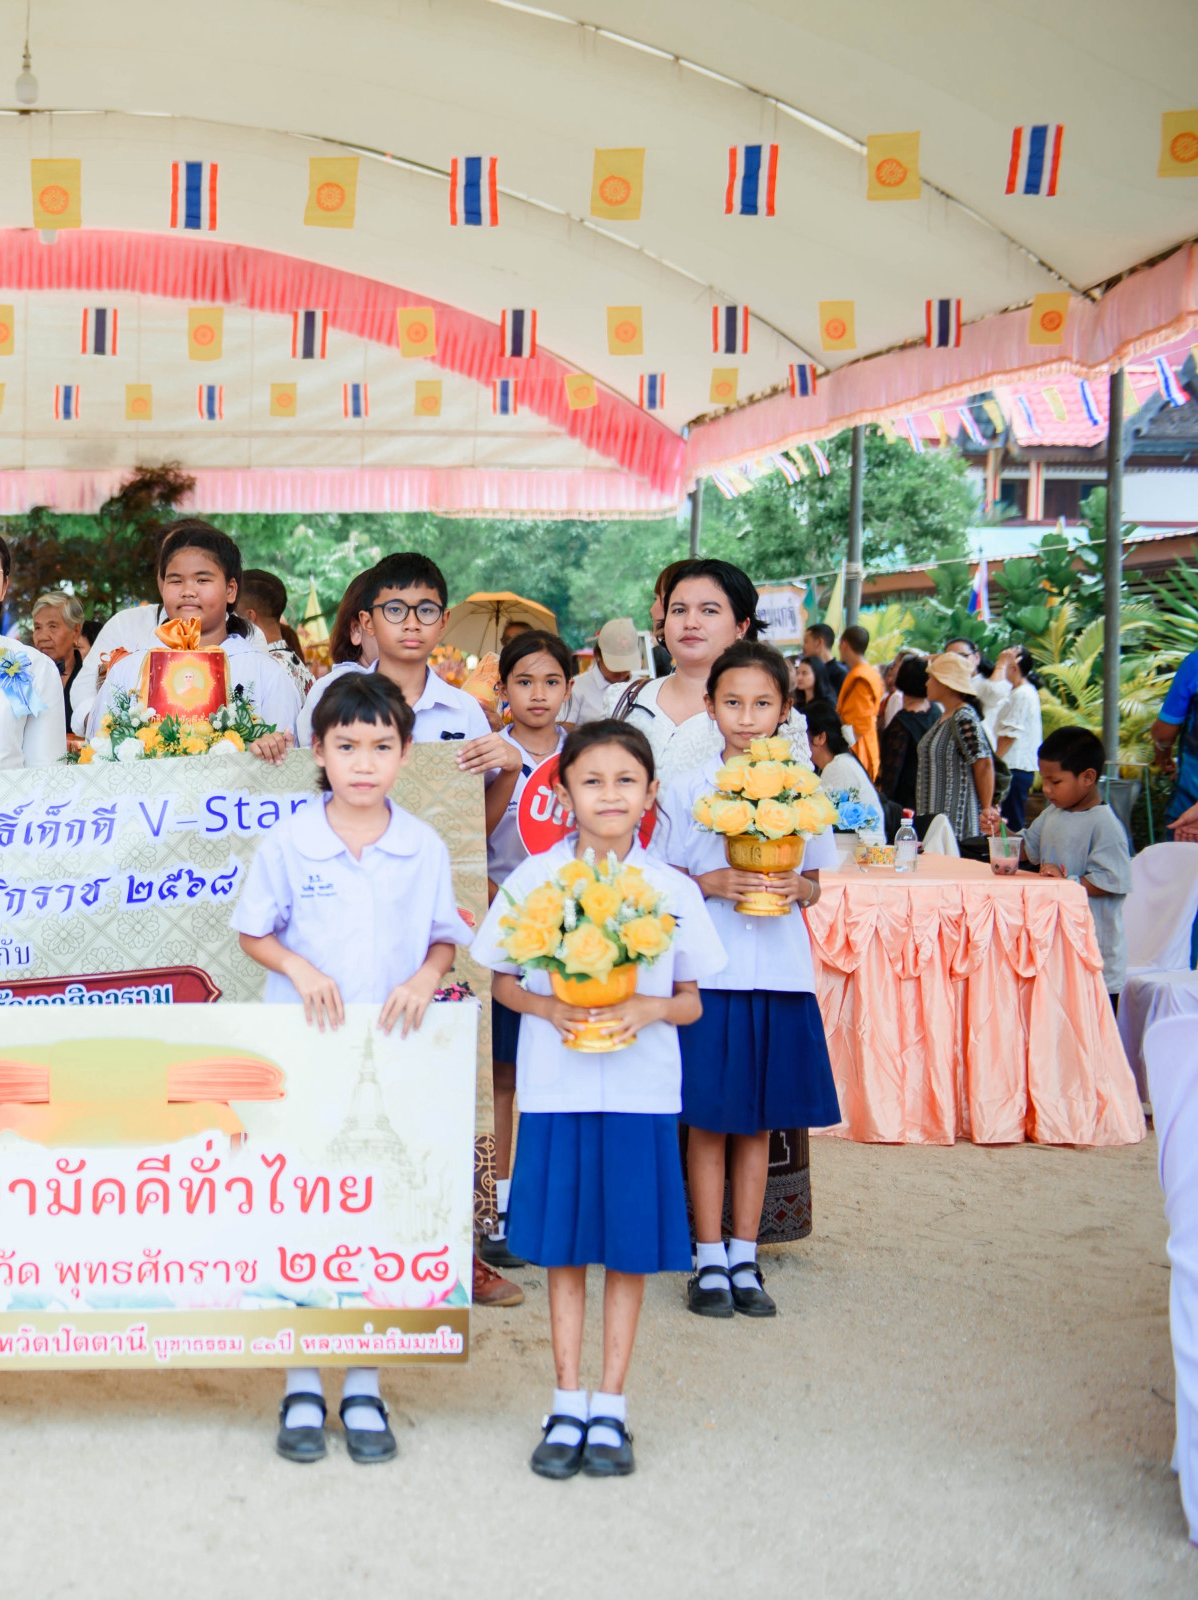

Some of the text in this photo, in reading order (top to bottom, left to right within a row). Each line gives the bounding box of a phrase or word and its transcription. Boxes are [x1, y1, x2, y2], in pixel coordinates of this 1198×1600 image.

[125, 864, 239, 905] ๒๕๖๘
[54, 1248, 259, 1300] พุทธศักราช
[277, 1244, 450, 1284] ๒๕๖๘
